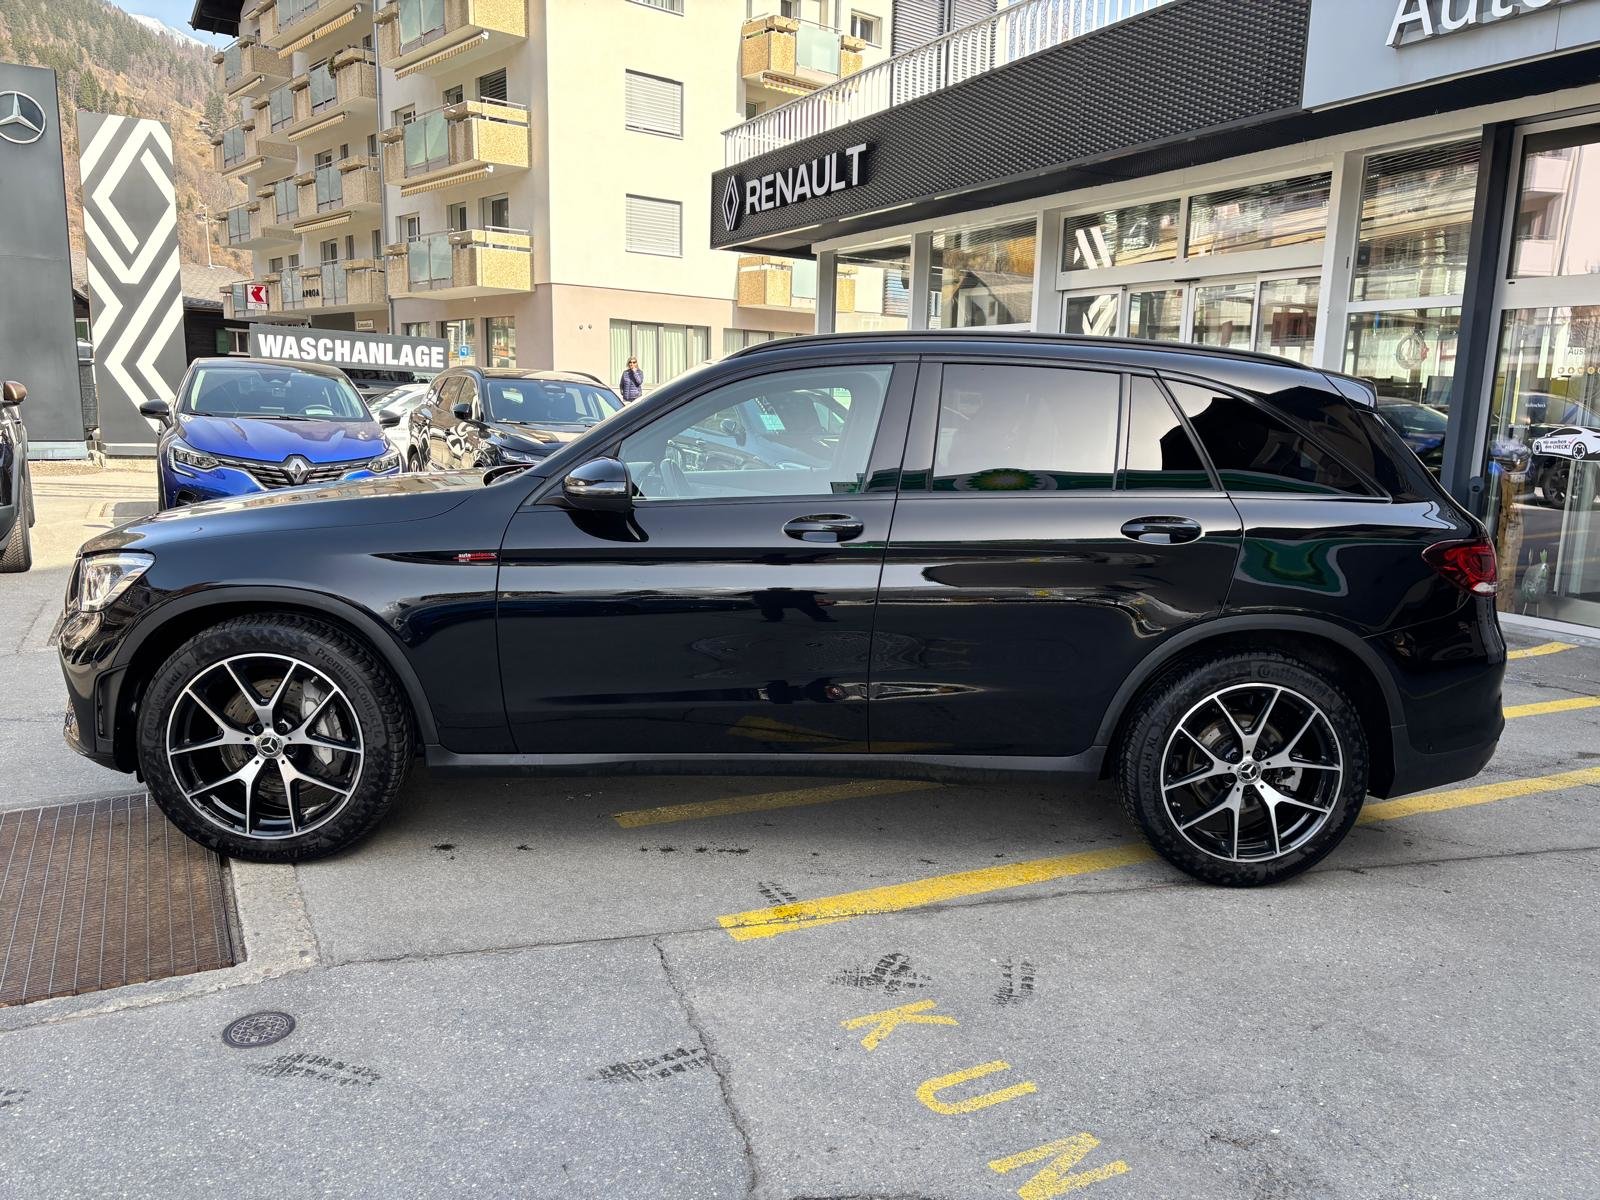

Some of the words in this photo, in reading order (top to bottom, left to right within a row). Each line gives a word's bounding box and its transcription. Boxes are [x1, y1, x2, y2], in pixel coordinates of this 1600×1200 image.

[1385, 0, 1556, 47] Au
[745, 142, 867, 215] RENAULT
[257, 333, 445, 368] WASCHANLAGE
